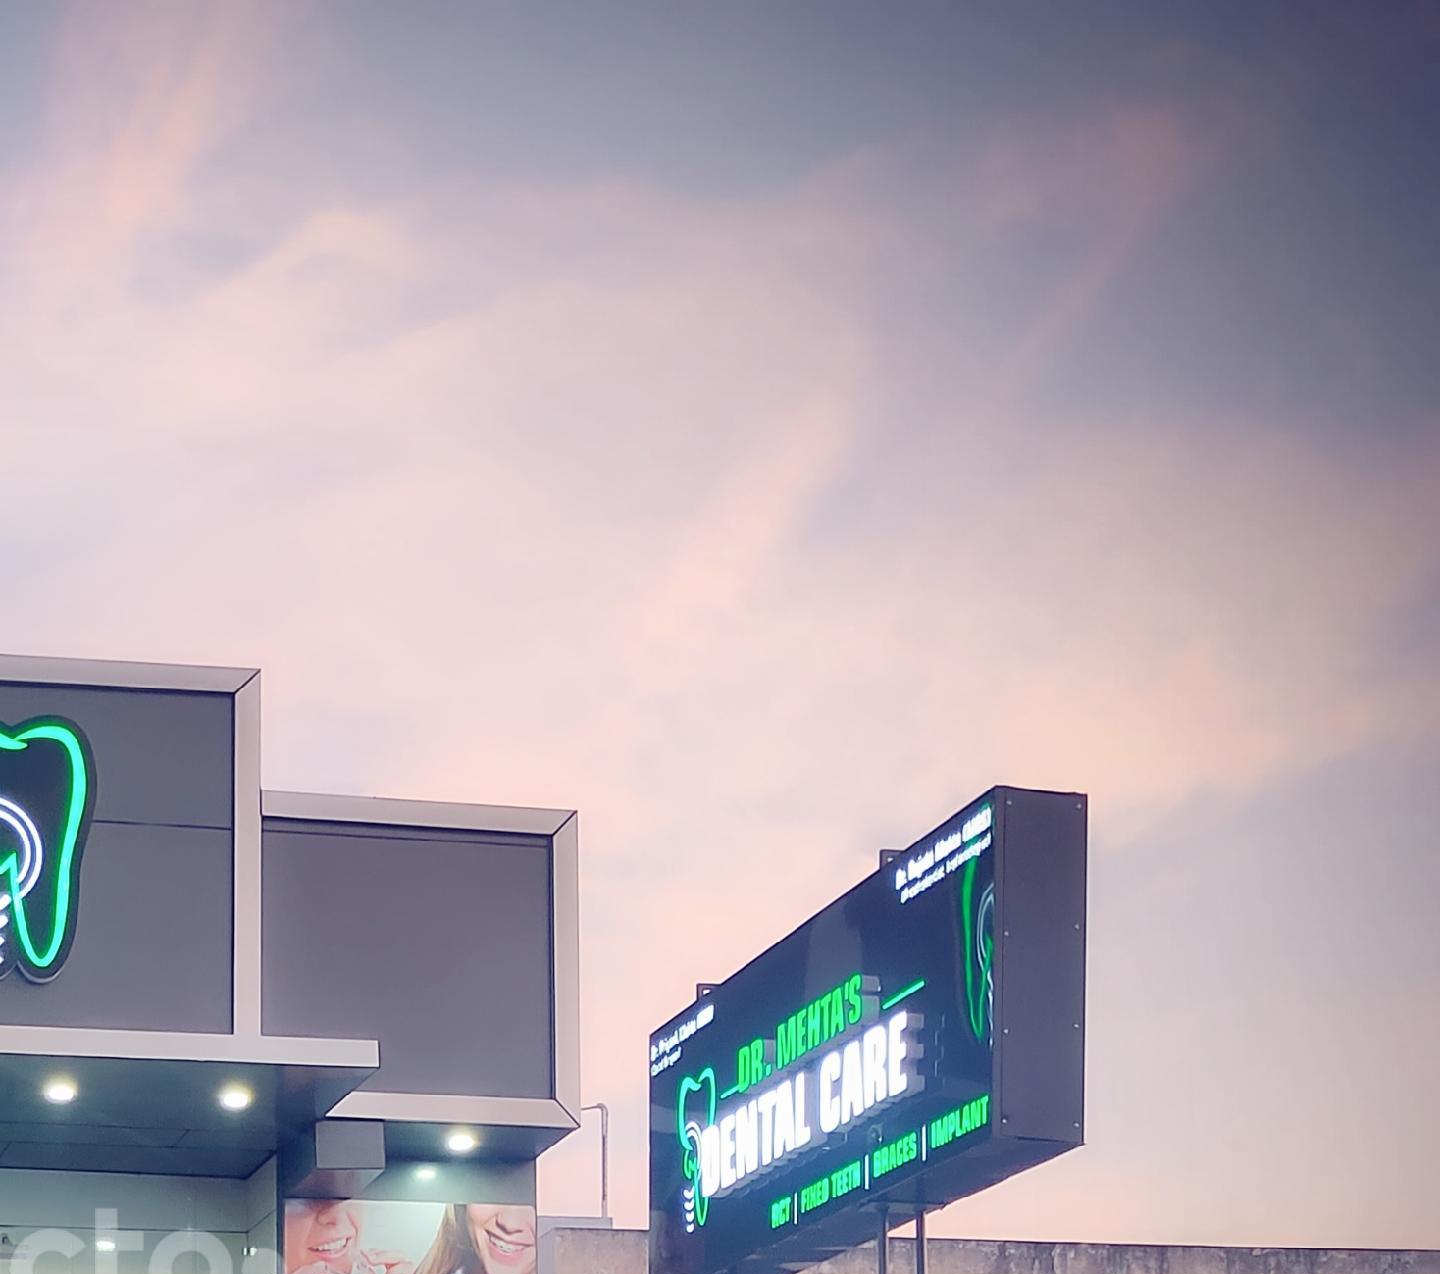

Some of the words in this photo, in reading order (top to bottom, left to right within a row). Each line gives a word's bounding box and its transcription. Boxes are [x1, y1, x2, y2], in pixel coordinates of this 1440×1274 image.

[737, 1038, 772, 1093] DR.
[777, 974, 861, 1070] MEHTA'S
[701, 1072, 811, 1198] DENTAL
[819, 1010, 908, 1133] CARE
[771, 1196, 792, 1229] RCT
[800, 1178, 830, 1214] FIXED
[831, 1160, 861, 1198] TEETH
[873, 1132, 917, 1178] BRACES
[930, 1095, 989, 1149] IMPLANT
